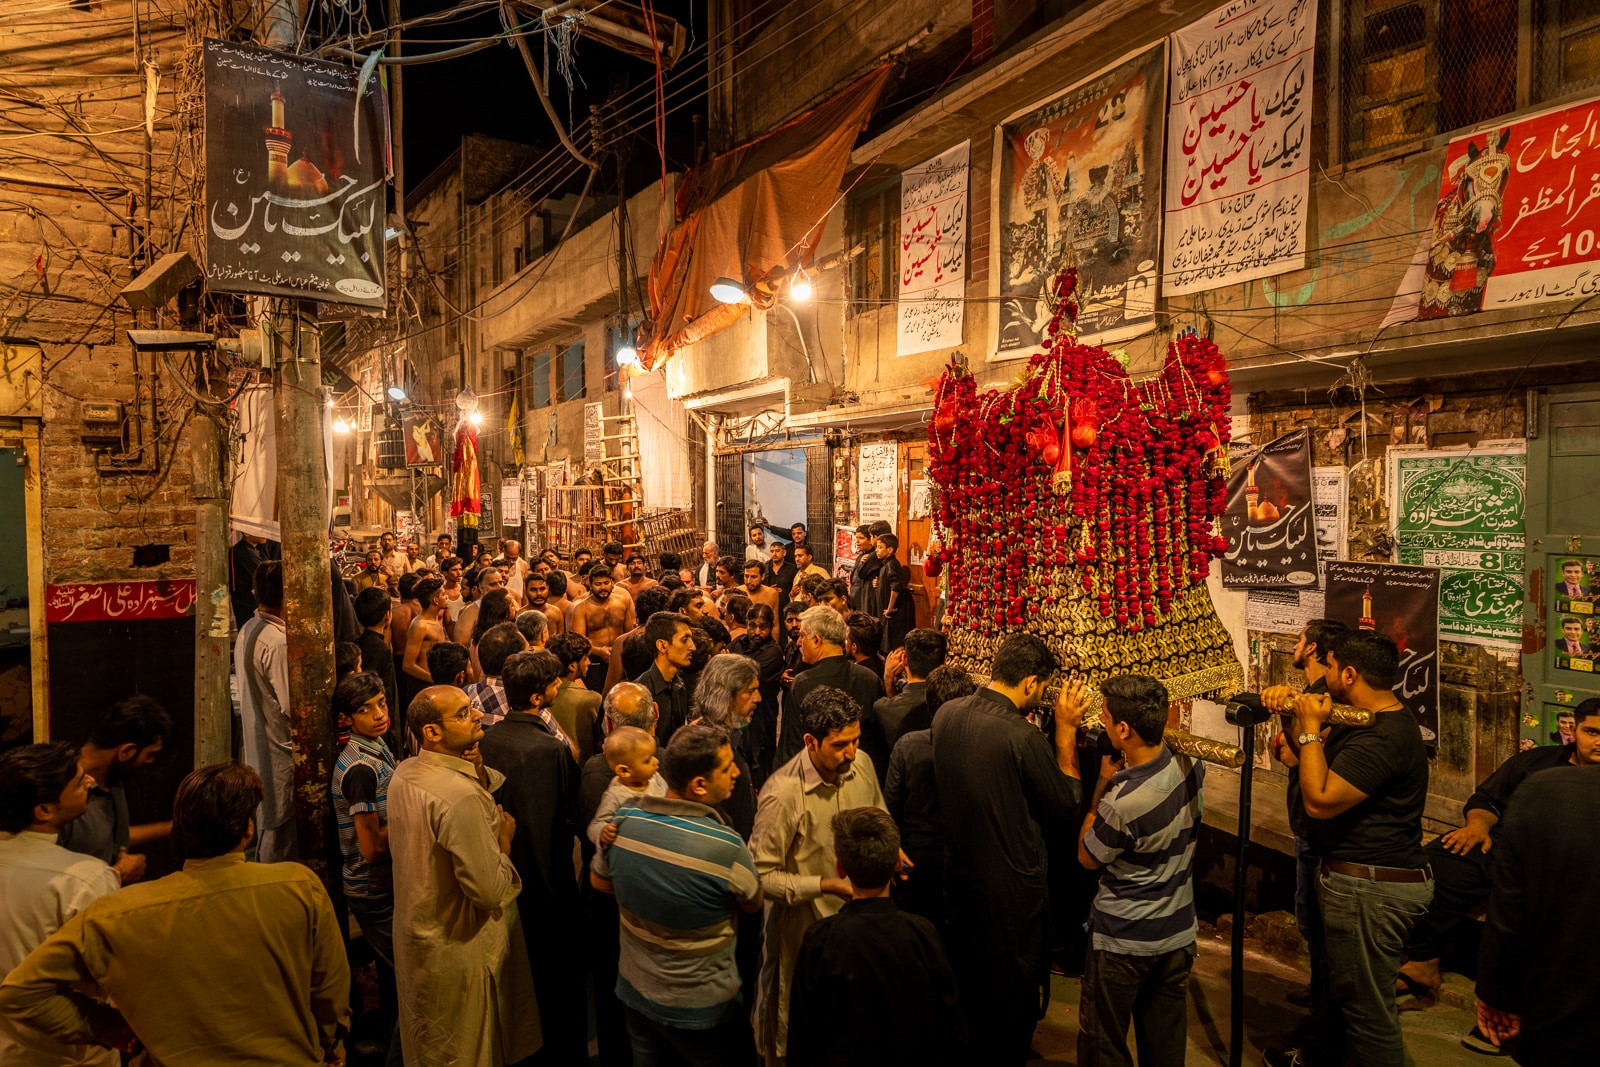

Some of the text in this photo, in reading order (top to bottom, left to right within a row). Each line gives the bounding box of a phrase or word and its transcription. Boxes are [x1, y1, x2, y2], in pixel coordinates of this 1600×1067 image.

[1040, 88, 1109, 126] PRODUCTION
[1480, 553, 1500, 570] 8
[1464, 591, 1523, 616] مہندی
